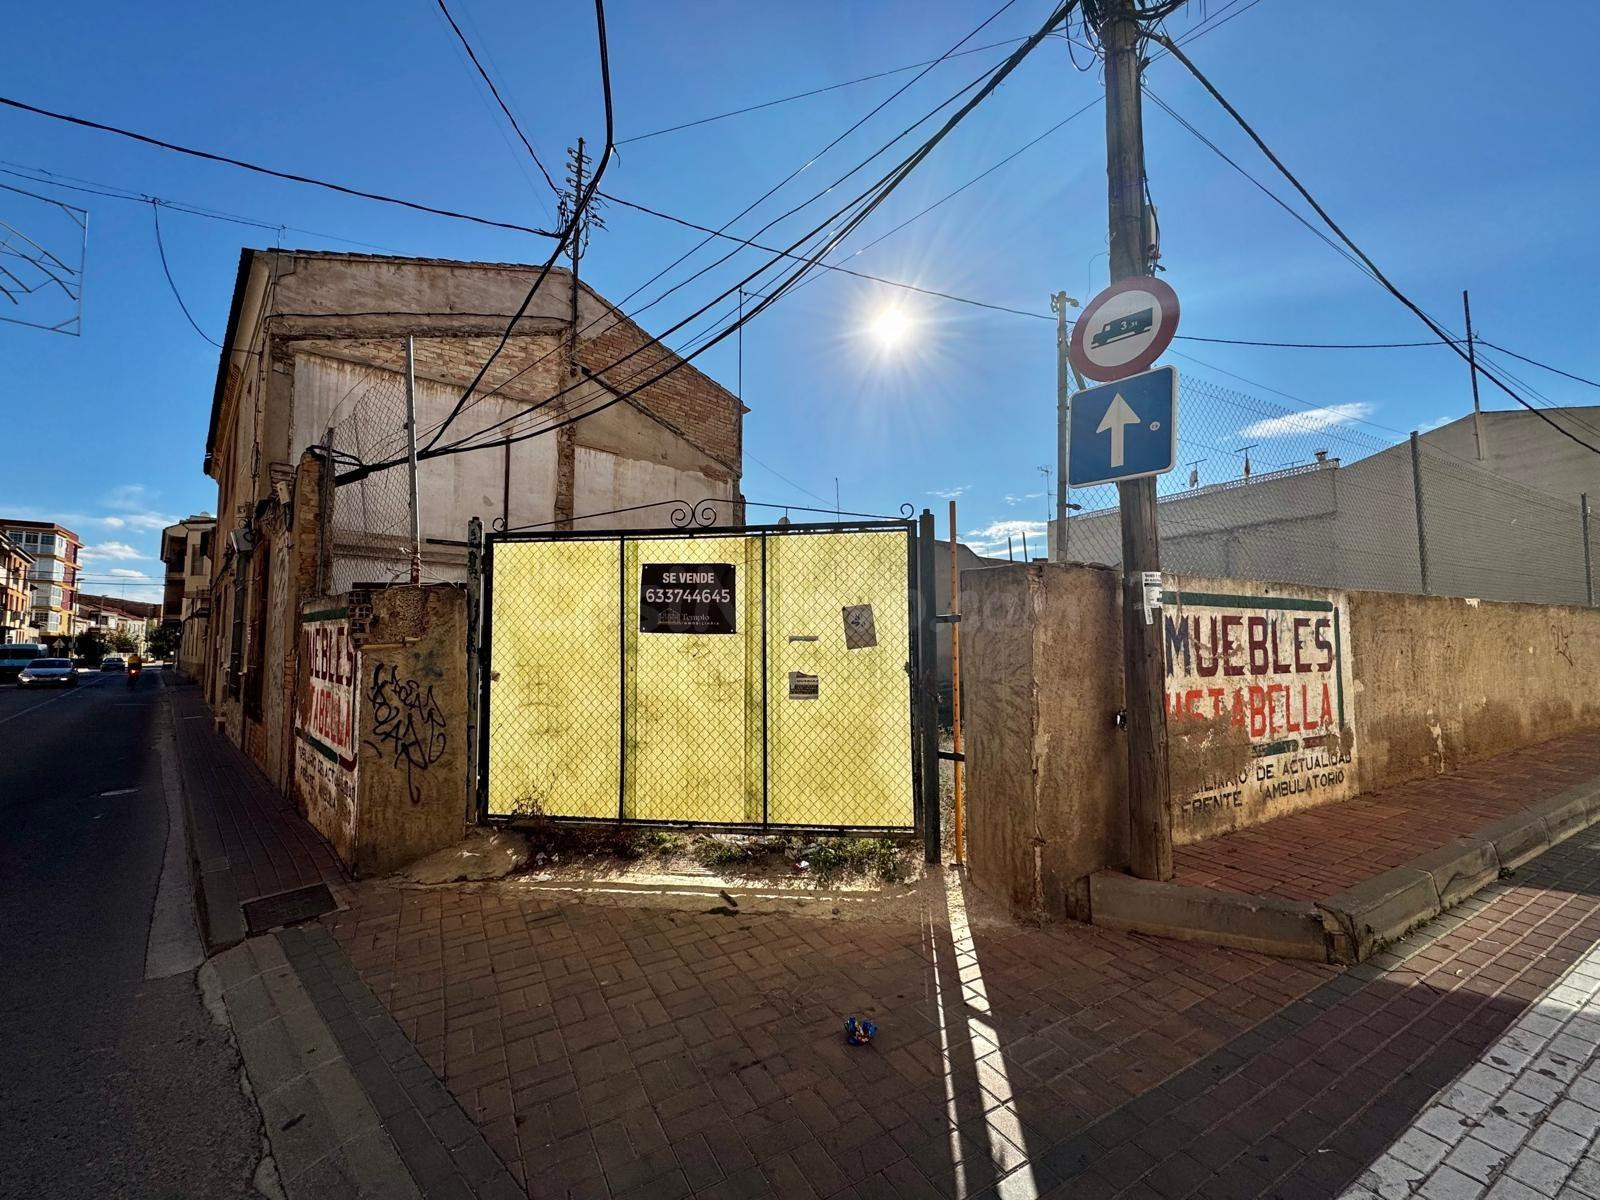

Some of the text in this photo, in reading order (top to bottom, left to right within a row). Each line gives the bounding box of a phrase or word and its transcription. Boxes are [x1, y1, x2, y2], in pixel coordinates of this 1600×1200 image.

[662, 572, 715, 584] SE VENDE
[645, 589, 731, 604] 633744645
[1165, 614, 1334, 678] MUEBLES
[1255, 763, 1274, 782] DE
[1282, 751, 1352, 777] ACTUALIDAD
[1263, 770, 1345, 802] AMBULATORIO
